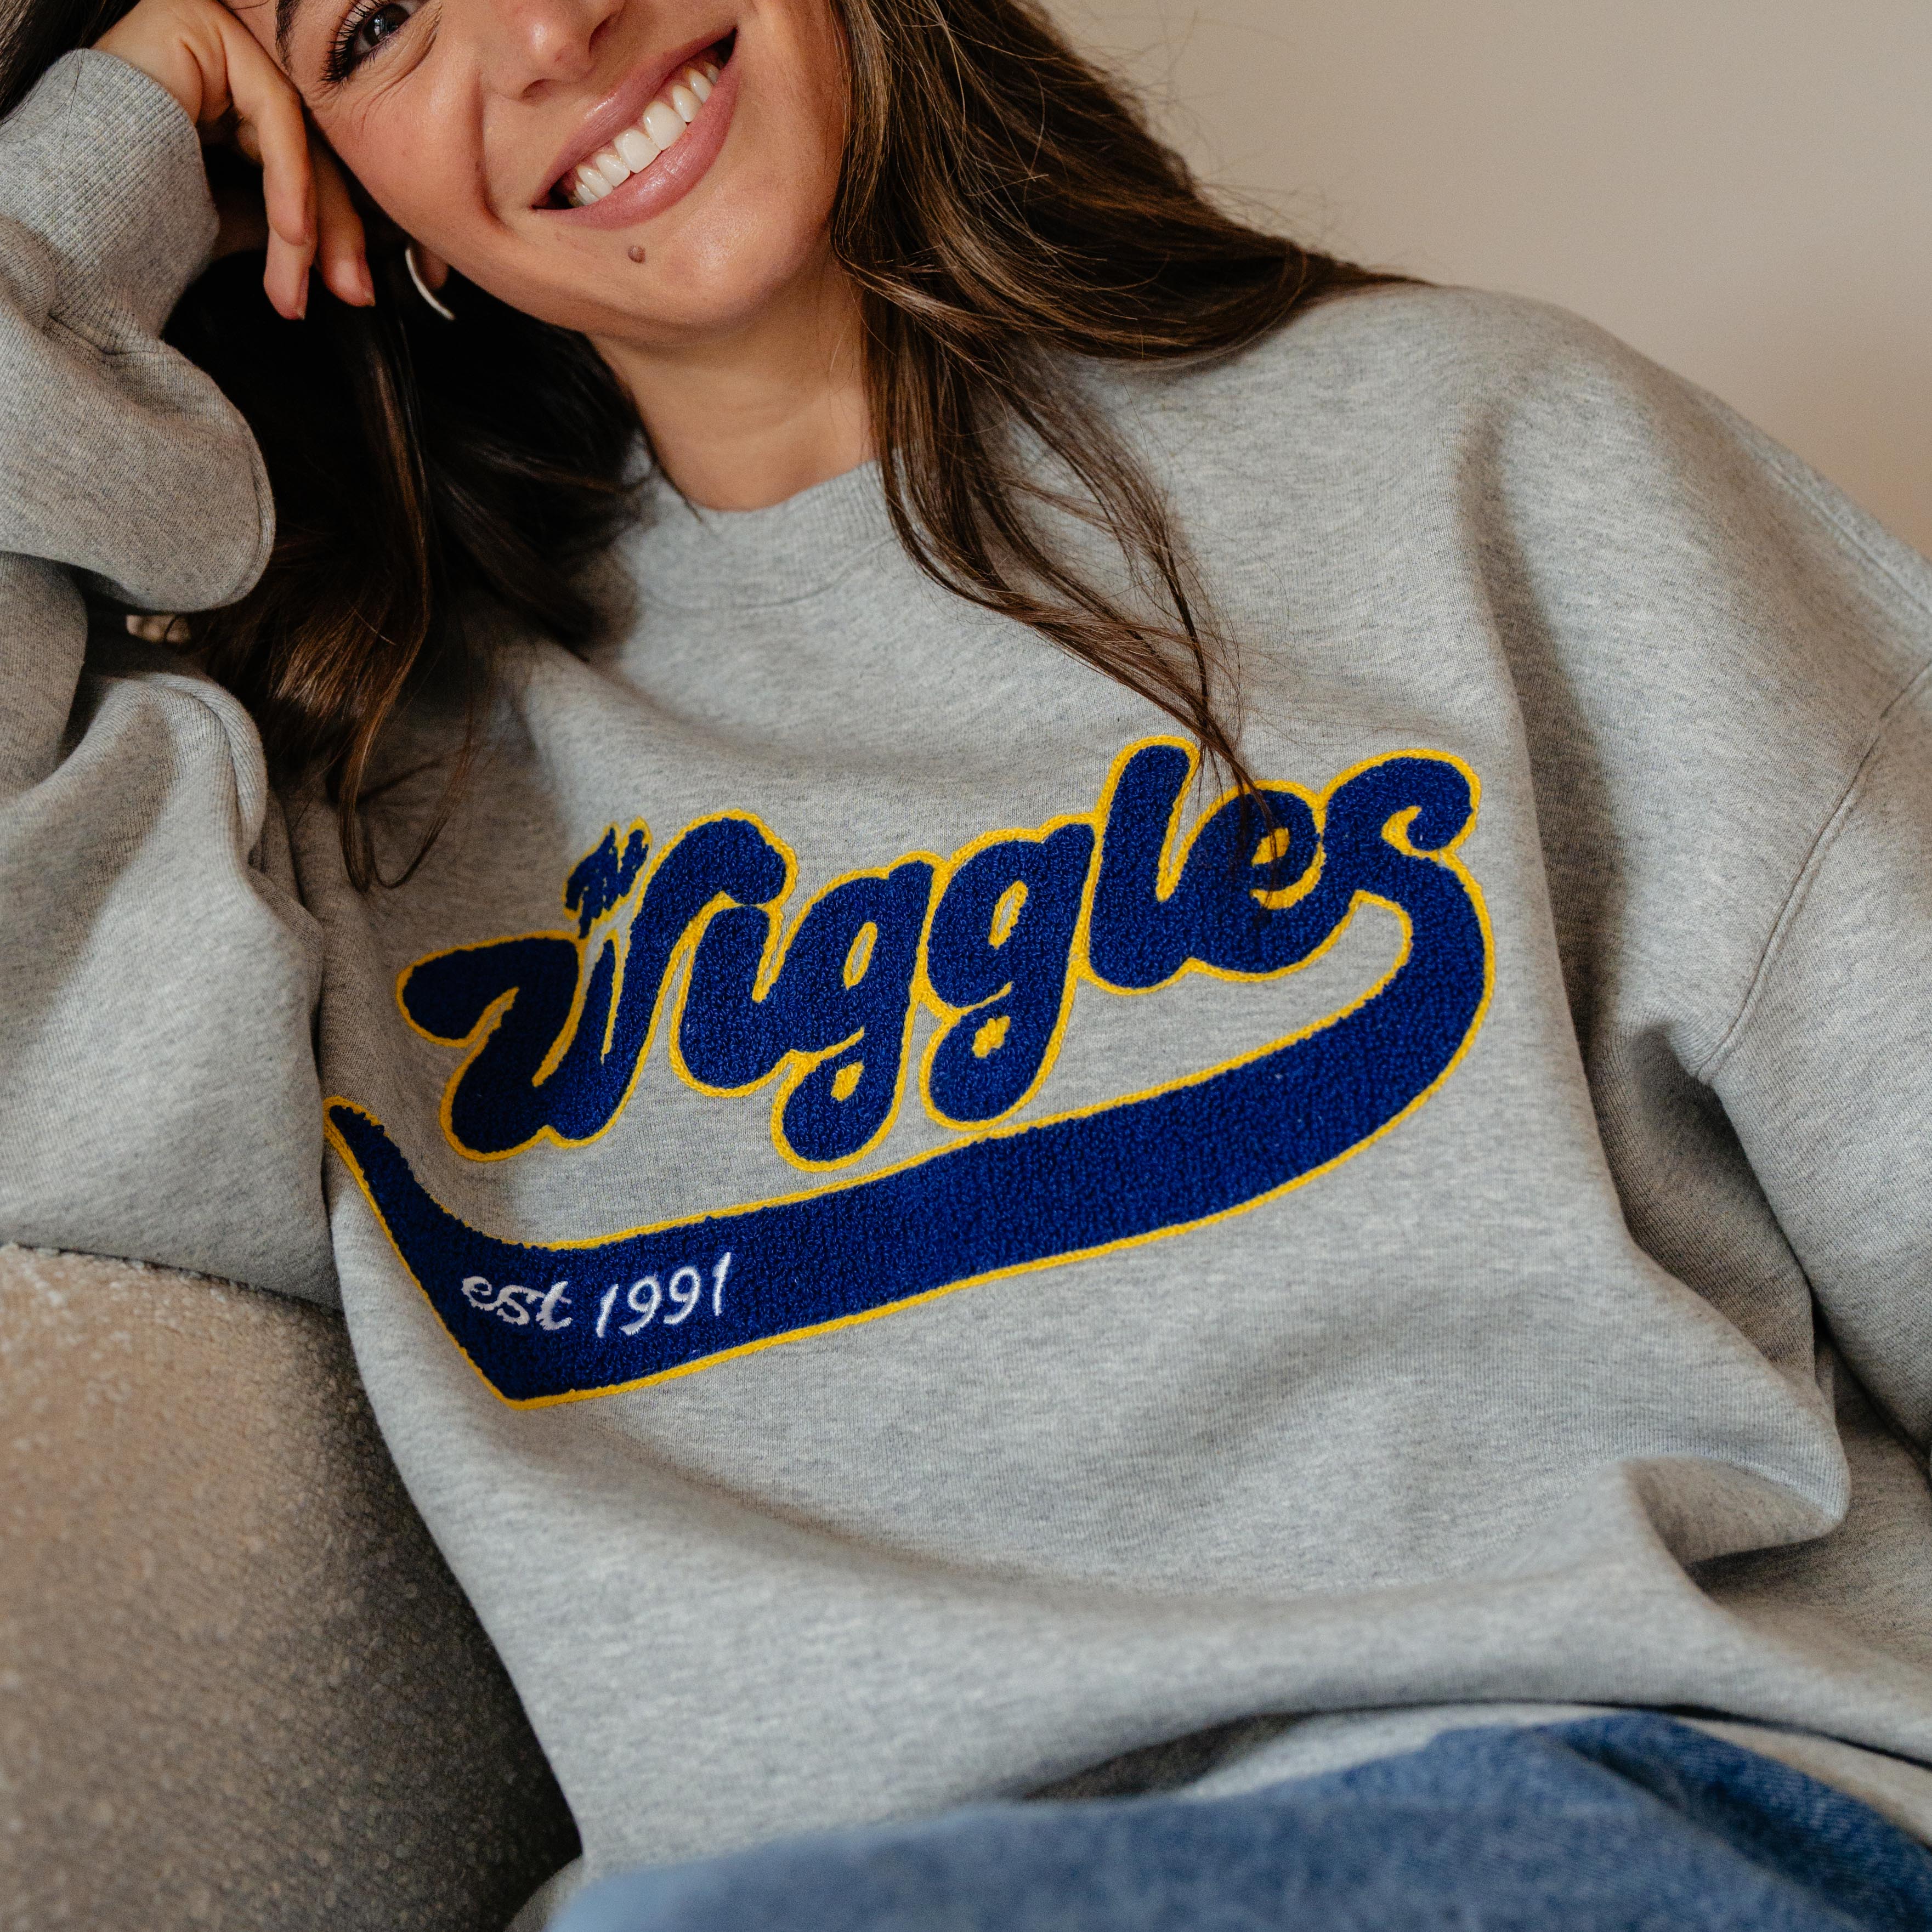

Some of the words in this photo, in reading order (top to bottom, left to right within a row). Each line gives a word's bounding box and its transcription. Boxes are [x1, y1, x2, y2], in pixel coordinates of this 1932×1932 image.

[396, 736, 1493, 1172] Wiggles
[462, 1276, 571, 1332] est
[596, 1252, 732, 1338] 1991
